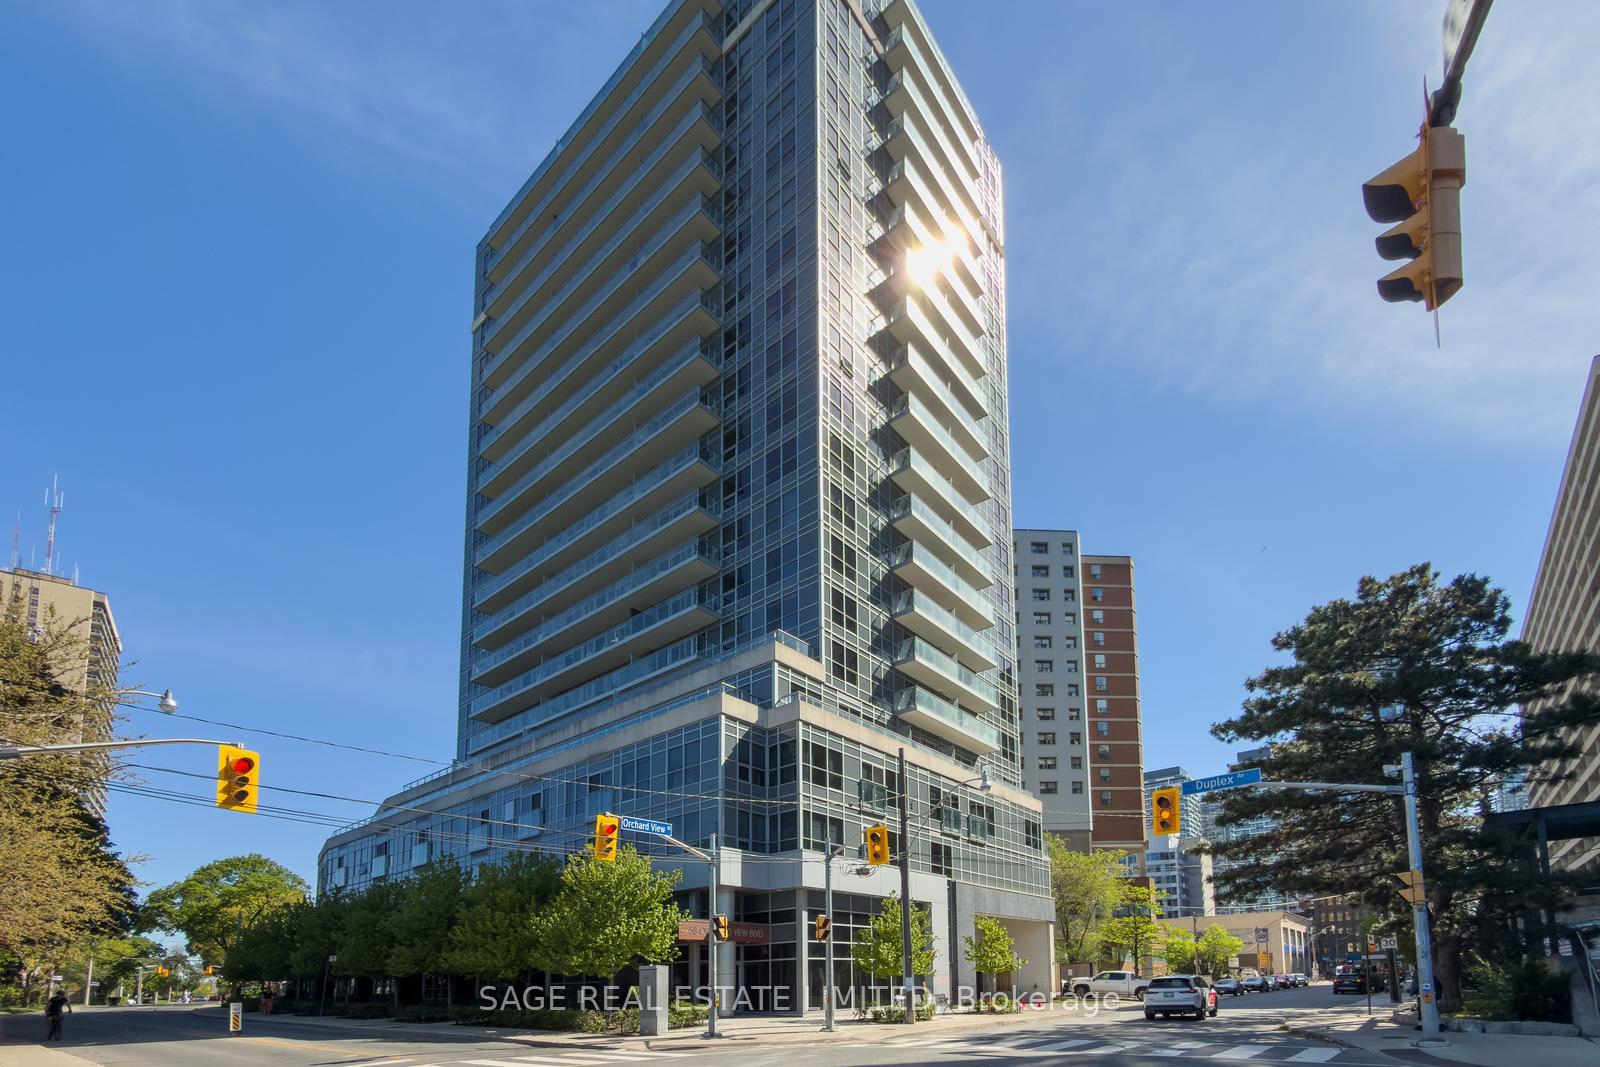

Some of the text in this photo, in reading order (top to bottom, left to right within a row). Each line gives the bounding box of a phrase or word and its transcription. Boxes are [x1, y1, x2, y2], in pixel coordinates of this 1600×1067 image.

[1195, 776, 1234, 790] Duplex
[623, 818, 649, 831] Orchard
[650, 823, 666, 833] View
[734, 927, 748, 937] VIEW
[749, 928, 764, 938] BLVD
[1383, 939, 1395, 947] 30
